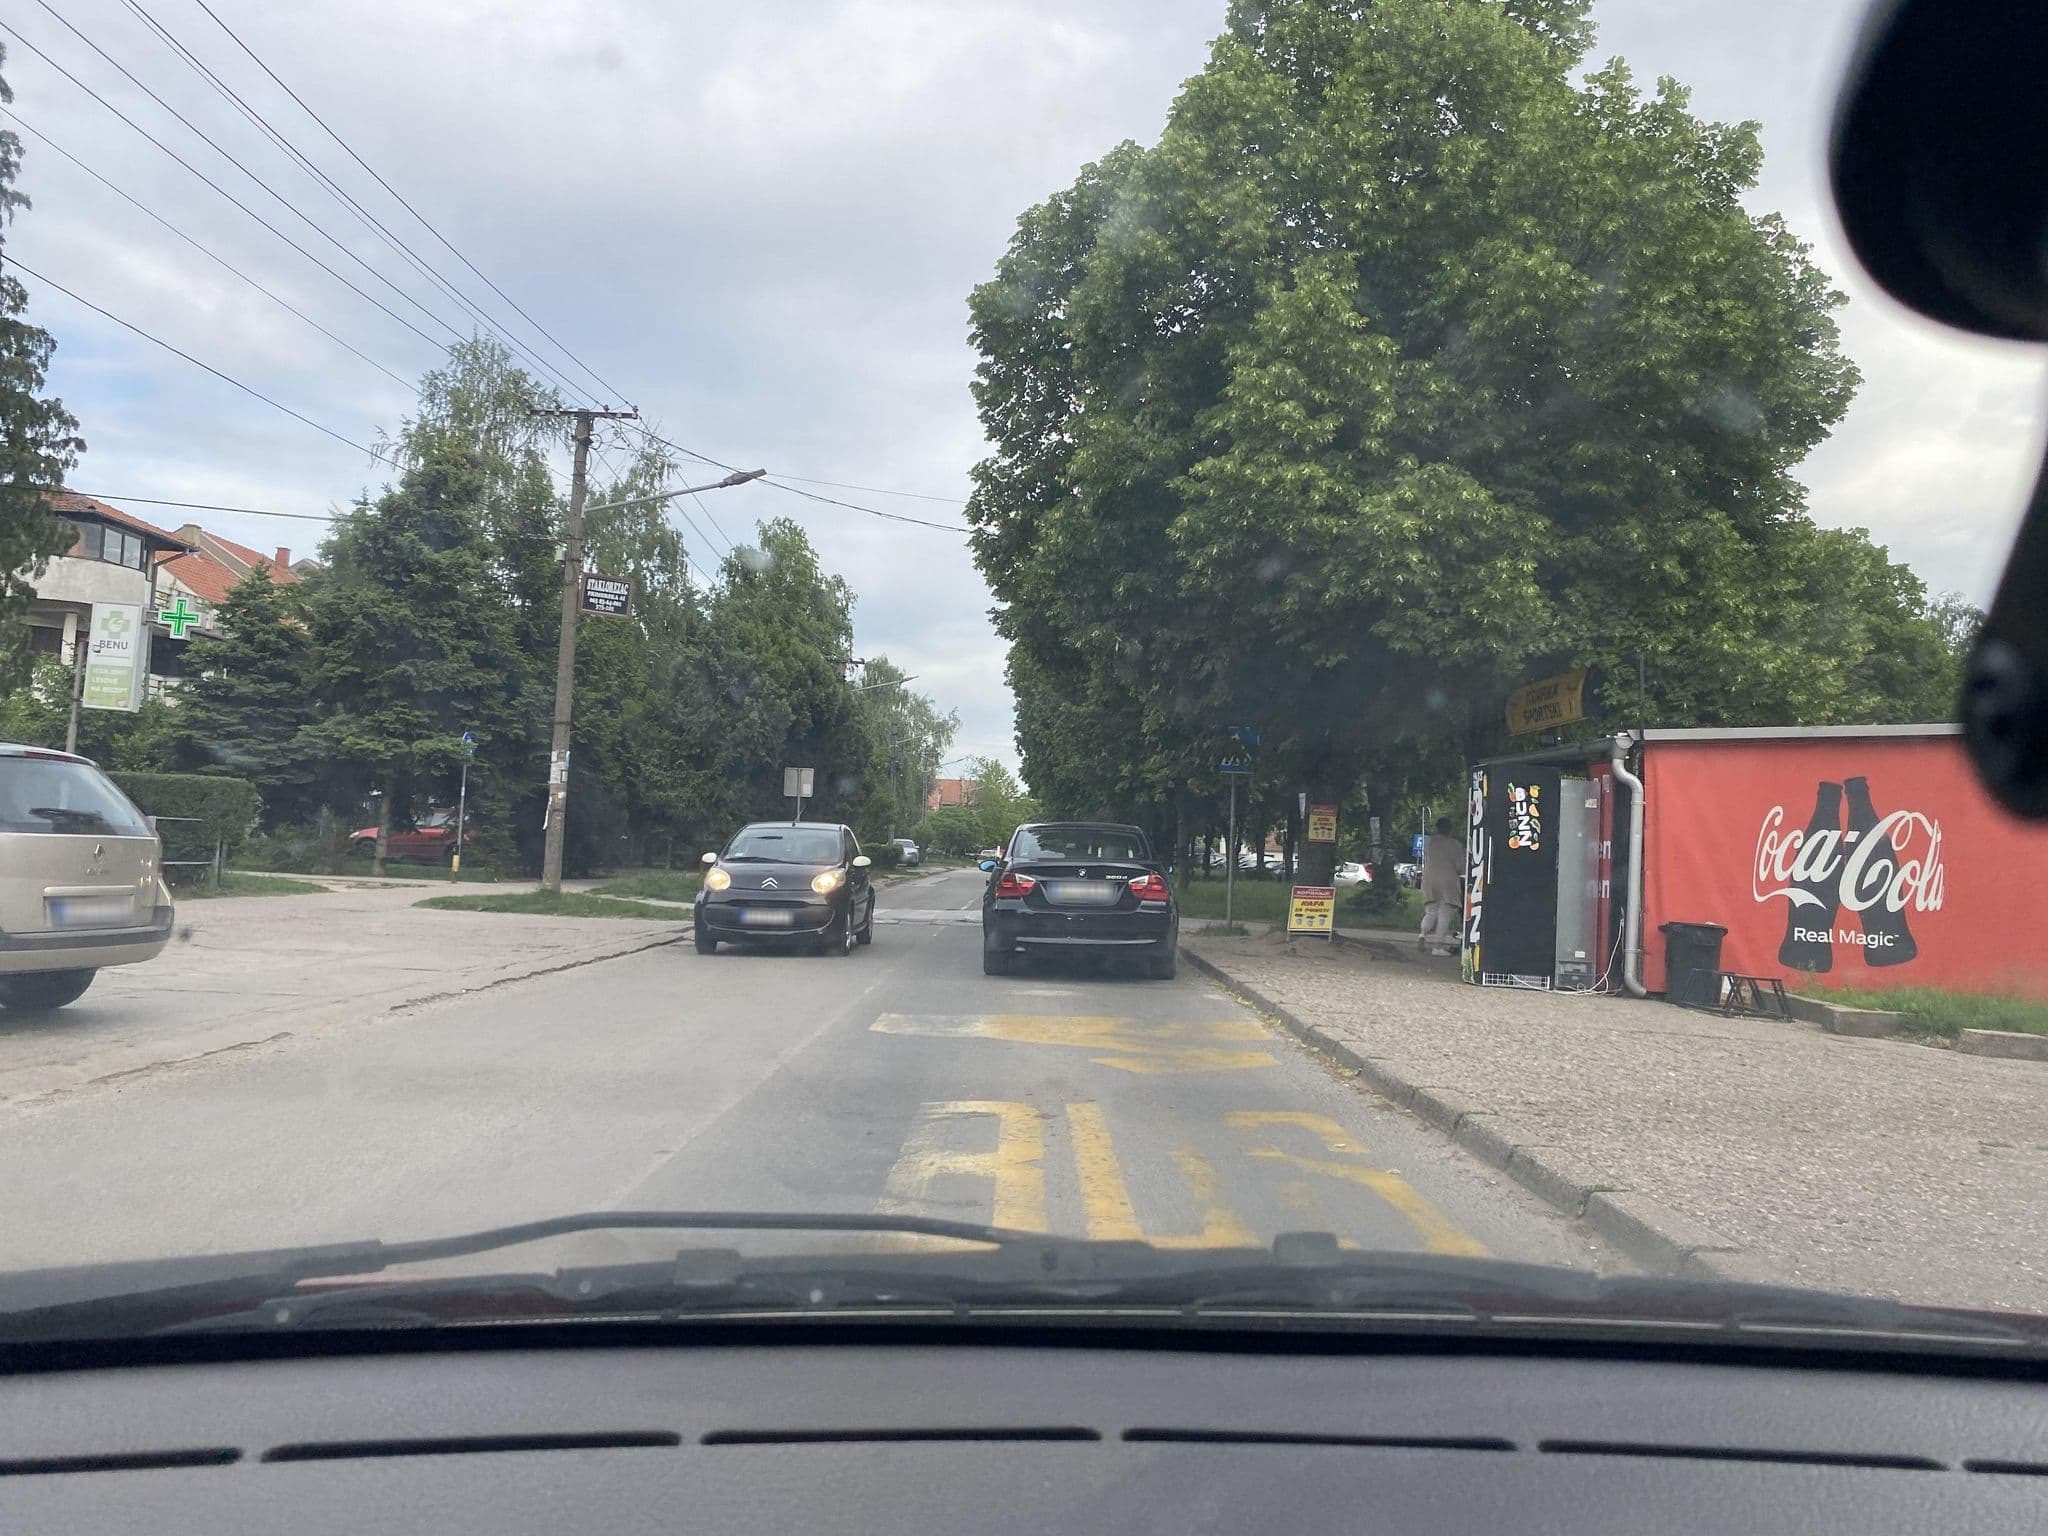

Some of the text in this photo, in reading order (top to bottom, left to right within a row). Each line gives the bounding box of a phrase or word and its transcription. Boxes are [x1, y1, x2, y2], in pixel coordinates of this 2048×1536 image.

[99, 640, 128, 650] BENU
[1516, 787, 1532, 846] BUZZ
[1753, 805, 1945, 913] Coca-Cola
[1794, 927, 1834, 944] Real
